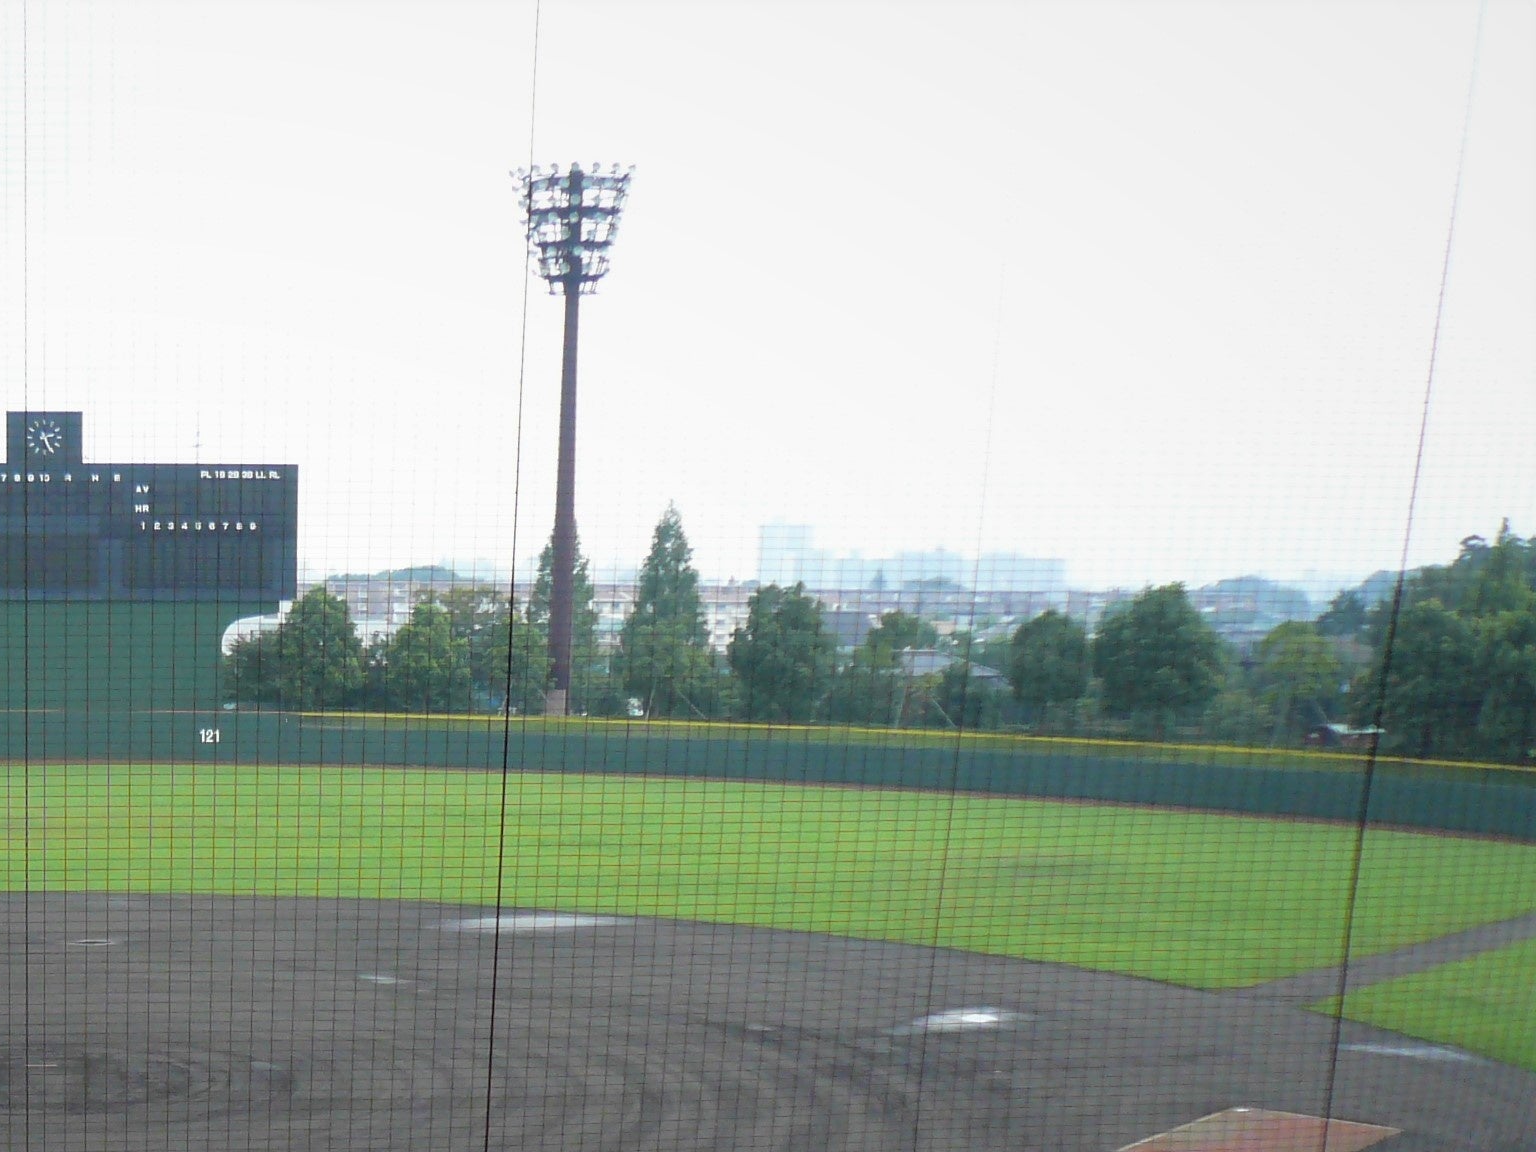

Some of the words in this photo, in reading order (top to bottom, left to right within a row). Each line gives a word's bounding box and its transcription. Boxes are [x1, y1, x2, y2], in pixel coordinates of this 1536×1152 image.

[0, 472, 8, 483] 7
[13, 472, 21, 483] 8
[26, 472, 35, 483] 9
[38, 472, 51, 483] 10
[135, 484, 150, 494] AV
[134, 503, 150, 514] HR
[140, 520, 146, 531] 1
[153, 521, 162, 531] 2
[167, 521, 175, 531] 3
[180, 520, 189, 531] 4
[194, 521, 202, 531] 5
[208, 521, 216, 531] 6
[222, 521, 230, 531] 7
[235, 521, 243, 531] 8
[249, 521, 257, 531] 9
[199, 728, 220, 744] 121
